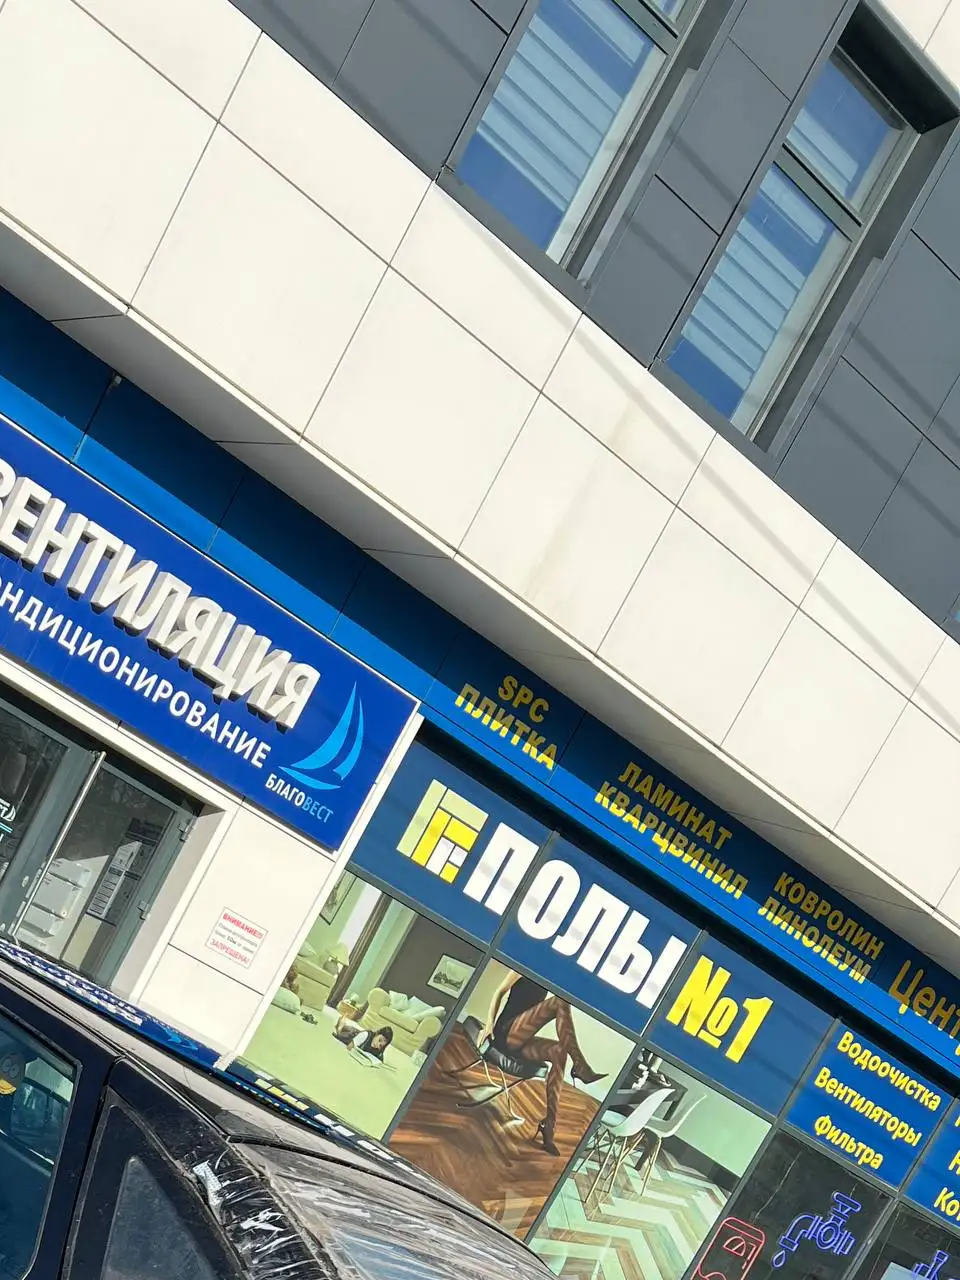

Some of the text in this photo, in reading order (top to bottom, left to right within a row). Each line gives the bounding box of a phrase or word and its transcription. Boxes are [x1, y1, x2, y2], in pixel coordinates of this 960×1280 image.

[455, 684, 557, 769] ПЛИТКА
[497, 675, 549, 723] SPC
[265, 773, 334, 823] БЛАГОВЕСТ
[618, 762, 733, 850] ЛАМИНАТ
[594, 782, 748, 899] КВАРЦВИНИЛ
[462, 822, 773, 1064] ПОЛЫ №1
[758, 896, 871, 984] ЛИНОЛЕУМ
[774, 873, 885, 960] КОВРОЛИН
[814, 1067, 922, 1146] Вентиляторы
[837, 1031, 941, 1111] Водоочистка
[814, 1115, 883, 1169] Фильтра
[933, 1186, 960, 1221] Ко
